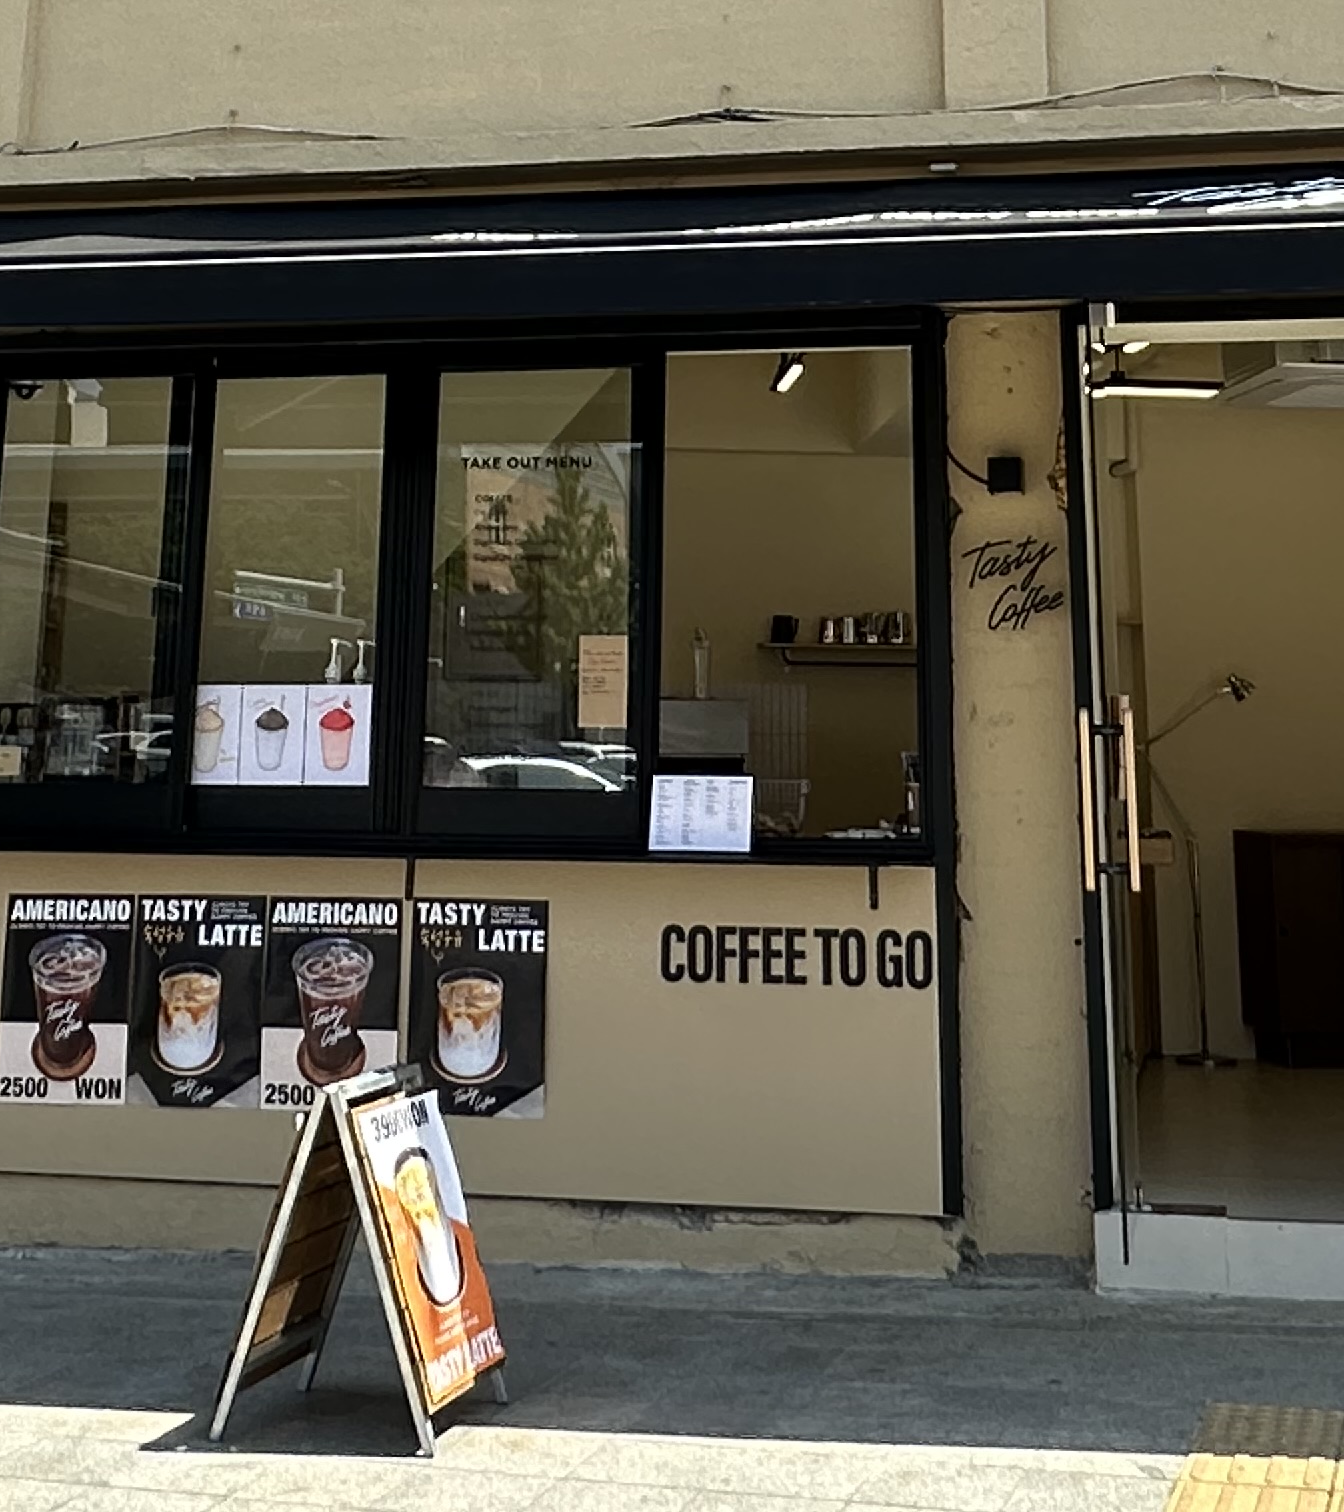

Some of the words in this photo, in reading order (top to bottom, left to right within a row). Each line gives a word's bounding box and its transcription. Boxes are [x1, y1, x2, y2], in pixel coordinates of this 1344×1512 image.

[461, 456, 502, 470] TAKE
[506, 456, 542, 470] OUT
[546, 455, 593, 470] MENU
[961, 535, 1058, 591] Tasty
[989, 584, 1064, 630] Coffee
[11, 898, 131, 922] AMERICANO
[142, 898, 207, 922] TASTY
[272, 902, 398, 926] AMERICANO
[417, 902, 487, 926] TASTY
[198, 924, 263, 947] LATTE
[478, 929, 546, 953] LATTE
[661, 924, 808, 986] COFFEE
[814, 928, 866, 988] TO
[877, 930, 933, 989] GO
[0, 1077, 48, 1098] 2500
[74, 1078, 122, 1099] WON
[264, 1083, 315, 1105] 2500
